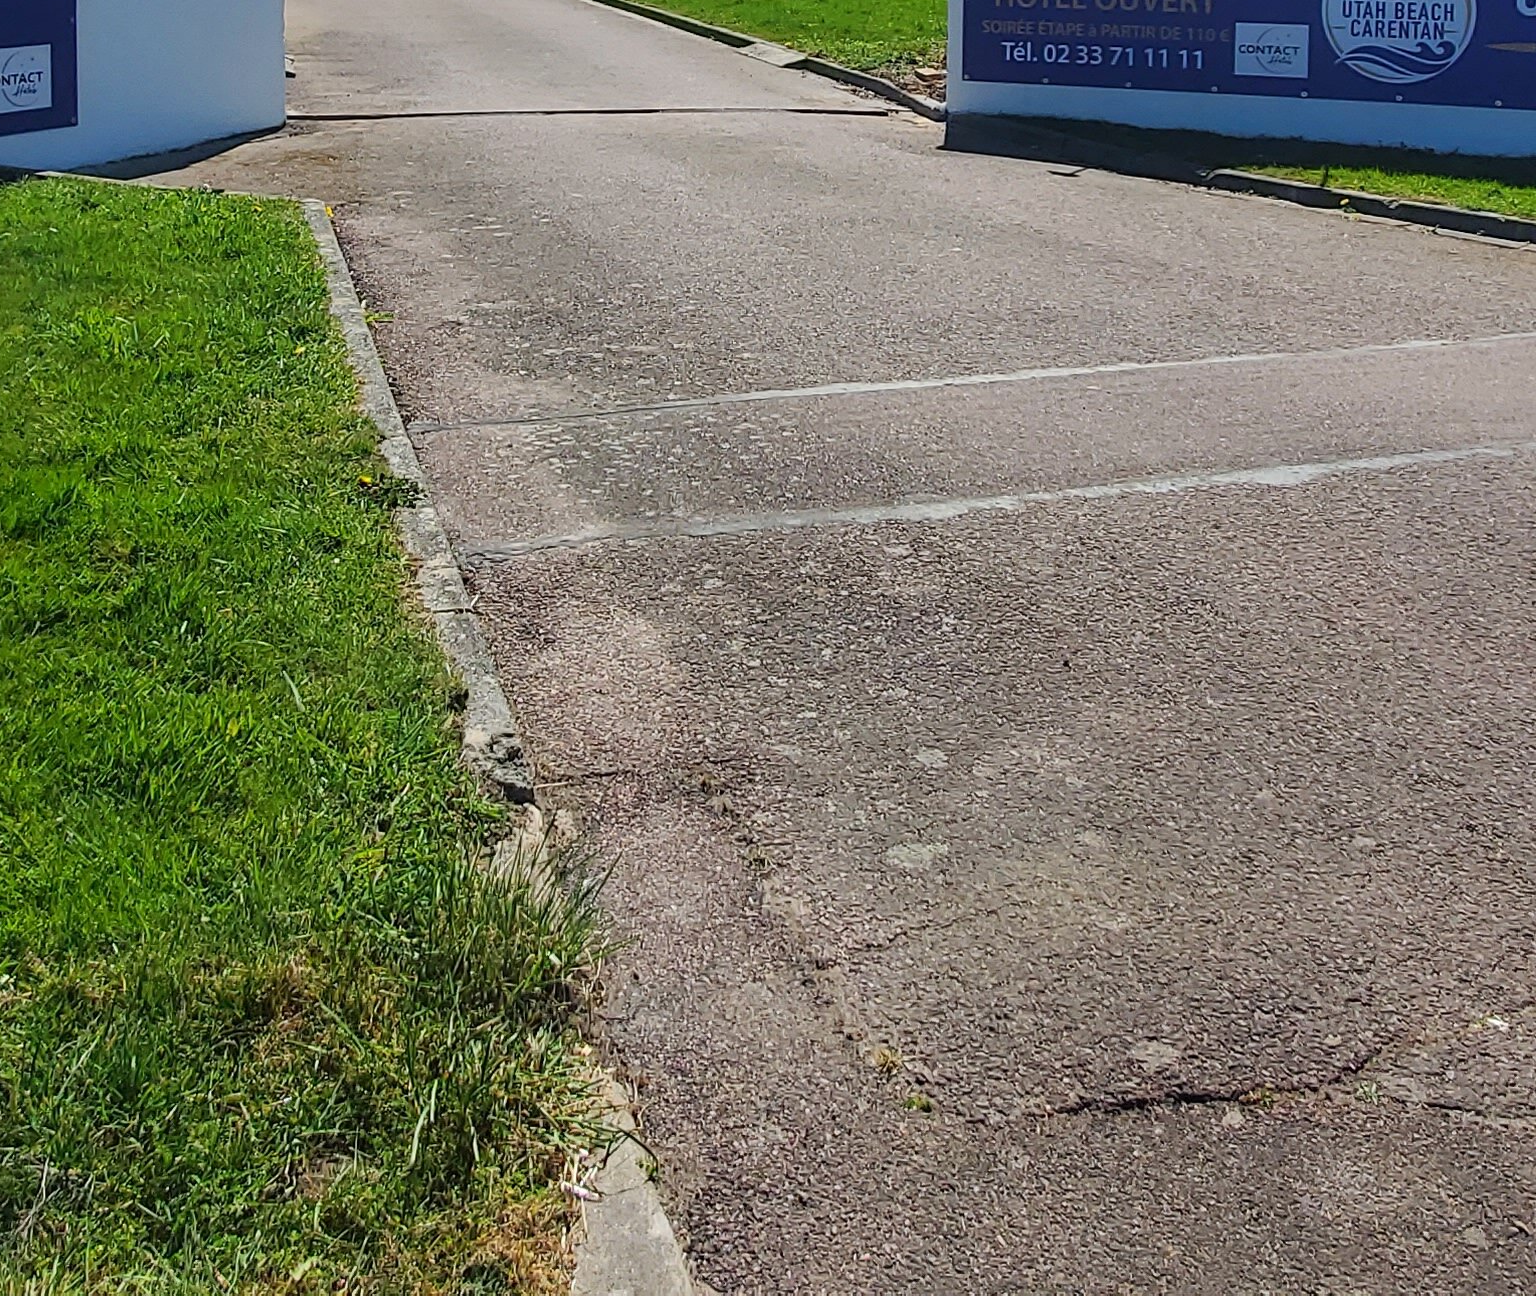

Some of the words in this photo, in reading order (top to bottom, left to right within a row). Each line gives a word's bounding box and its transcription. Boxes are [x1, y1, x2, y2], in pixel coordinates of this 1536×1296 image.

[1342, 0, 1386, 19] UTAH
[1394, 2, 1455, 22] BEACH
[1038, 18, 1085, 37] ÉTAPE
[1100, 23, 1157, 39] PARTIR
[1160, 26, 1182, 41] DE
[1187, 27, 1216, 42] 110
[1350, 19, 1445, 40] CARENTAN
[1001, 41, 1037, 63] Tél.
[1043, 44, 1068, 63] 02
[1075, 45, 1103, 65] 33
[1109, 46, 1134, 67] 71
[1144, 48, 1168, 68] 11
[1178, 50, 1203, 70] 11
[1238, 44, 1301, 56] CONTACT
